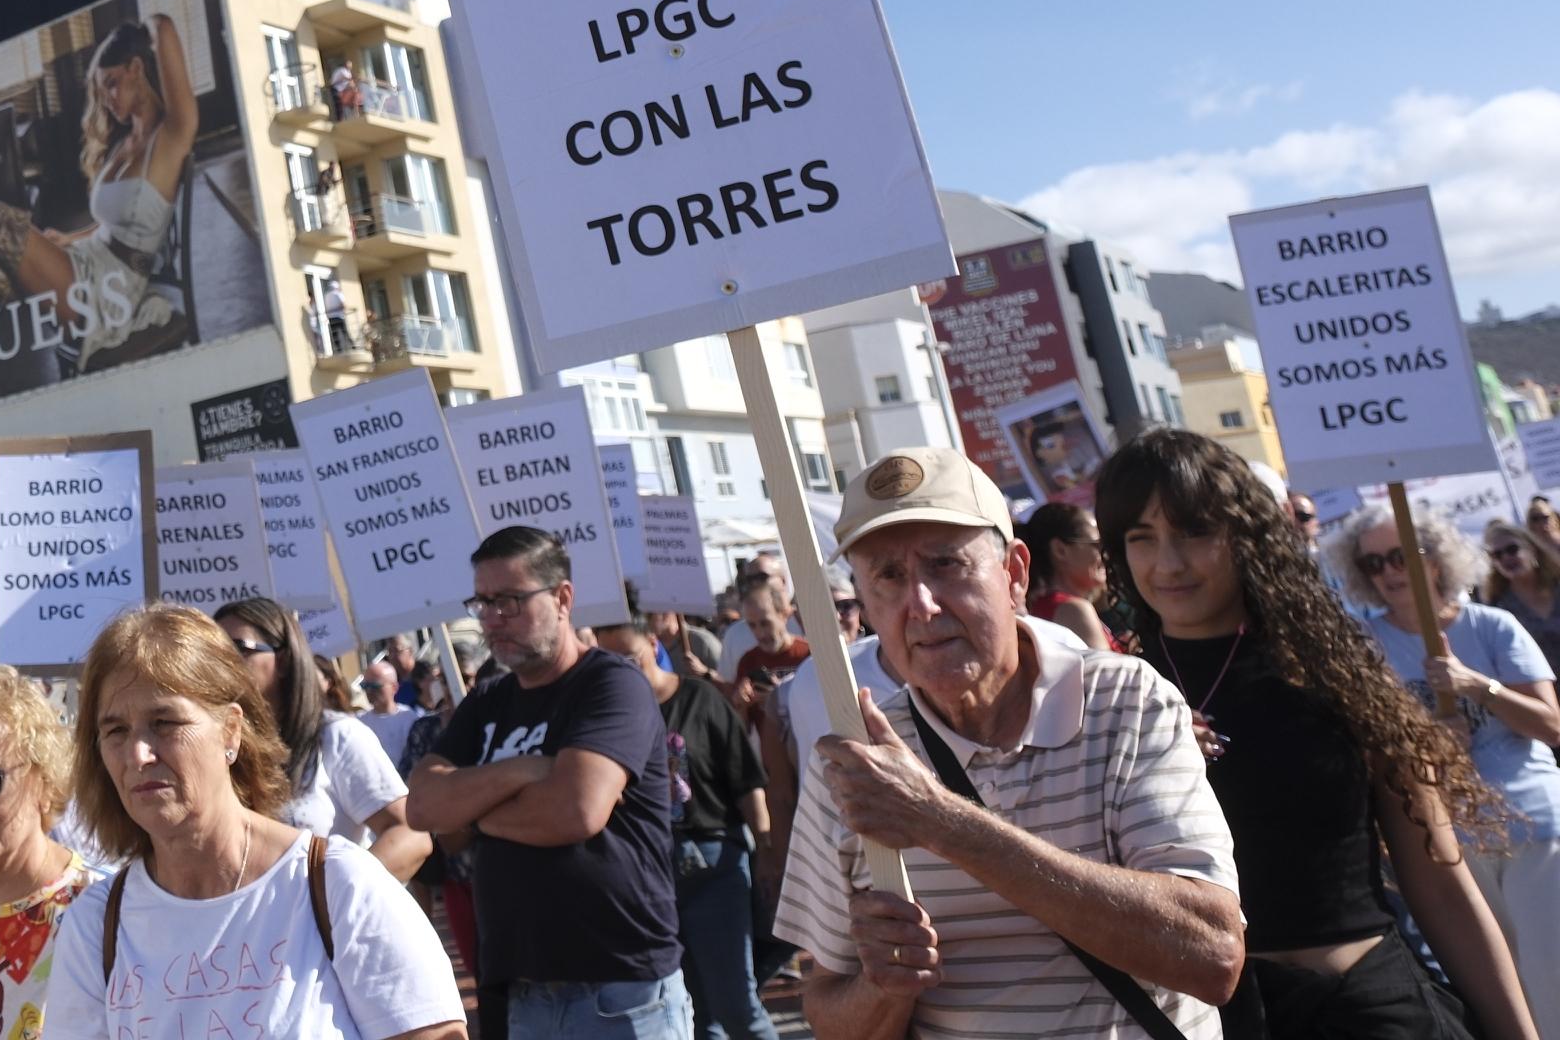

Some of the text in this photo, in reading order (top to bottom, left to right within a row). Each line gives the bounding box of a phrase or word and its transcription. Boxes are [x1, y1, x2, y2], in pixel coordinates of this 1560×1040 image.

[565, 60, 813, 167] CON LAS
[587, 159, 840, 266] TORRES
[1277, 226, 1389, 262] BARRIO
[1255, 264, 1432, 307] ESCALERITAS
[1294, 310, 1411, 345] UNIDOS
[1278, 346, 1448, 388] SOMOS MÁS
[334, 411, 404, 444] BARRIO
[1319, 397, 1409, 431] LPGC
[478, 421, 556, 450] BARRIO
[316, 436, 440, 482] SAN FRANCISCO
[477, 454, 571, 487] EL BATAN
[28, 478, 103, 496] BARRIO
[261, 494, 301, 509] NIDOS
[354, 472, 422, 502] UNIDOS
[0, 507, 133, 527] LOMO BLANCO
[155, 493, 227, 513] BARRIO
[344, 496, 451, 538] SOMOS MÁS
[490, 491, 572, 521] UNIDOS
[288, 515, 316, 530] MÁS
[554, 522, 597, 544] MÁS
[28, 538, 106, 557] UNIDOS
[268, 542, 297, 559] PGC
[371, 538, 435, 573] LPGC
[4, 566, 132, 590] SOMOS MÁS
[163, 555, 239, 576] UNIDOS
[161, 581, 260, 603] OMOS MÁS
[39, 604, 85, 621] LPGC
[109, 939, 288, 1006] LAS CASAS
